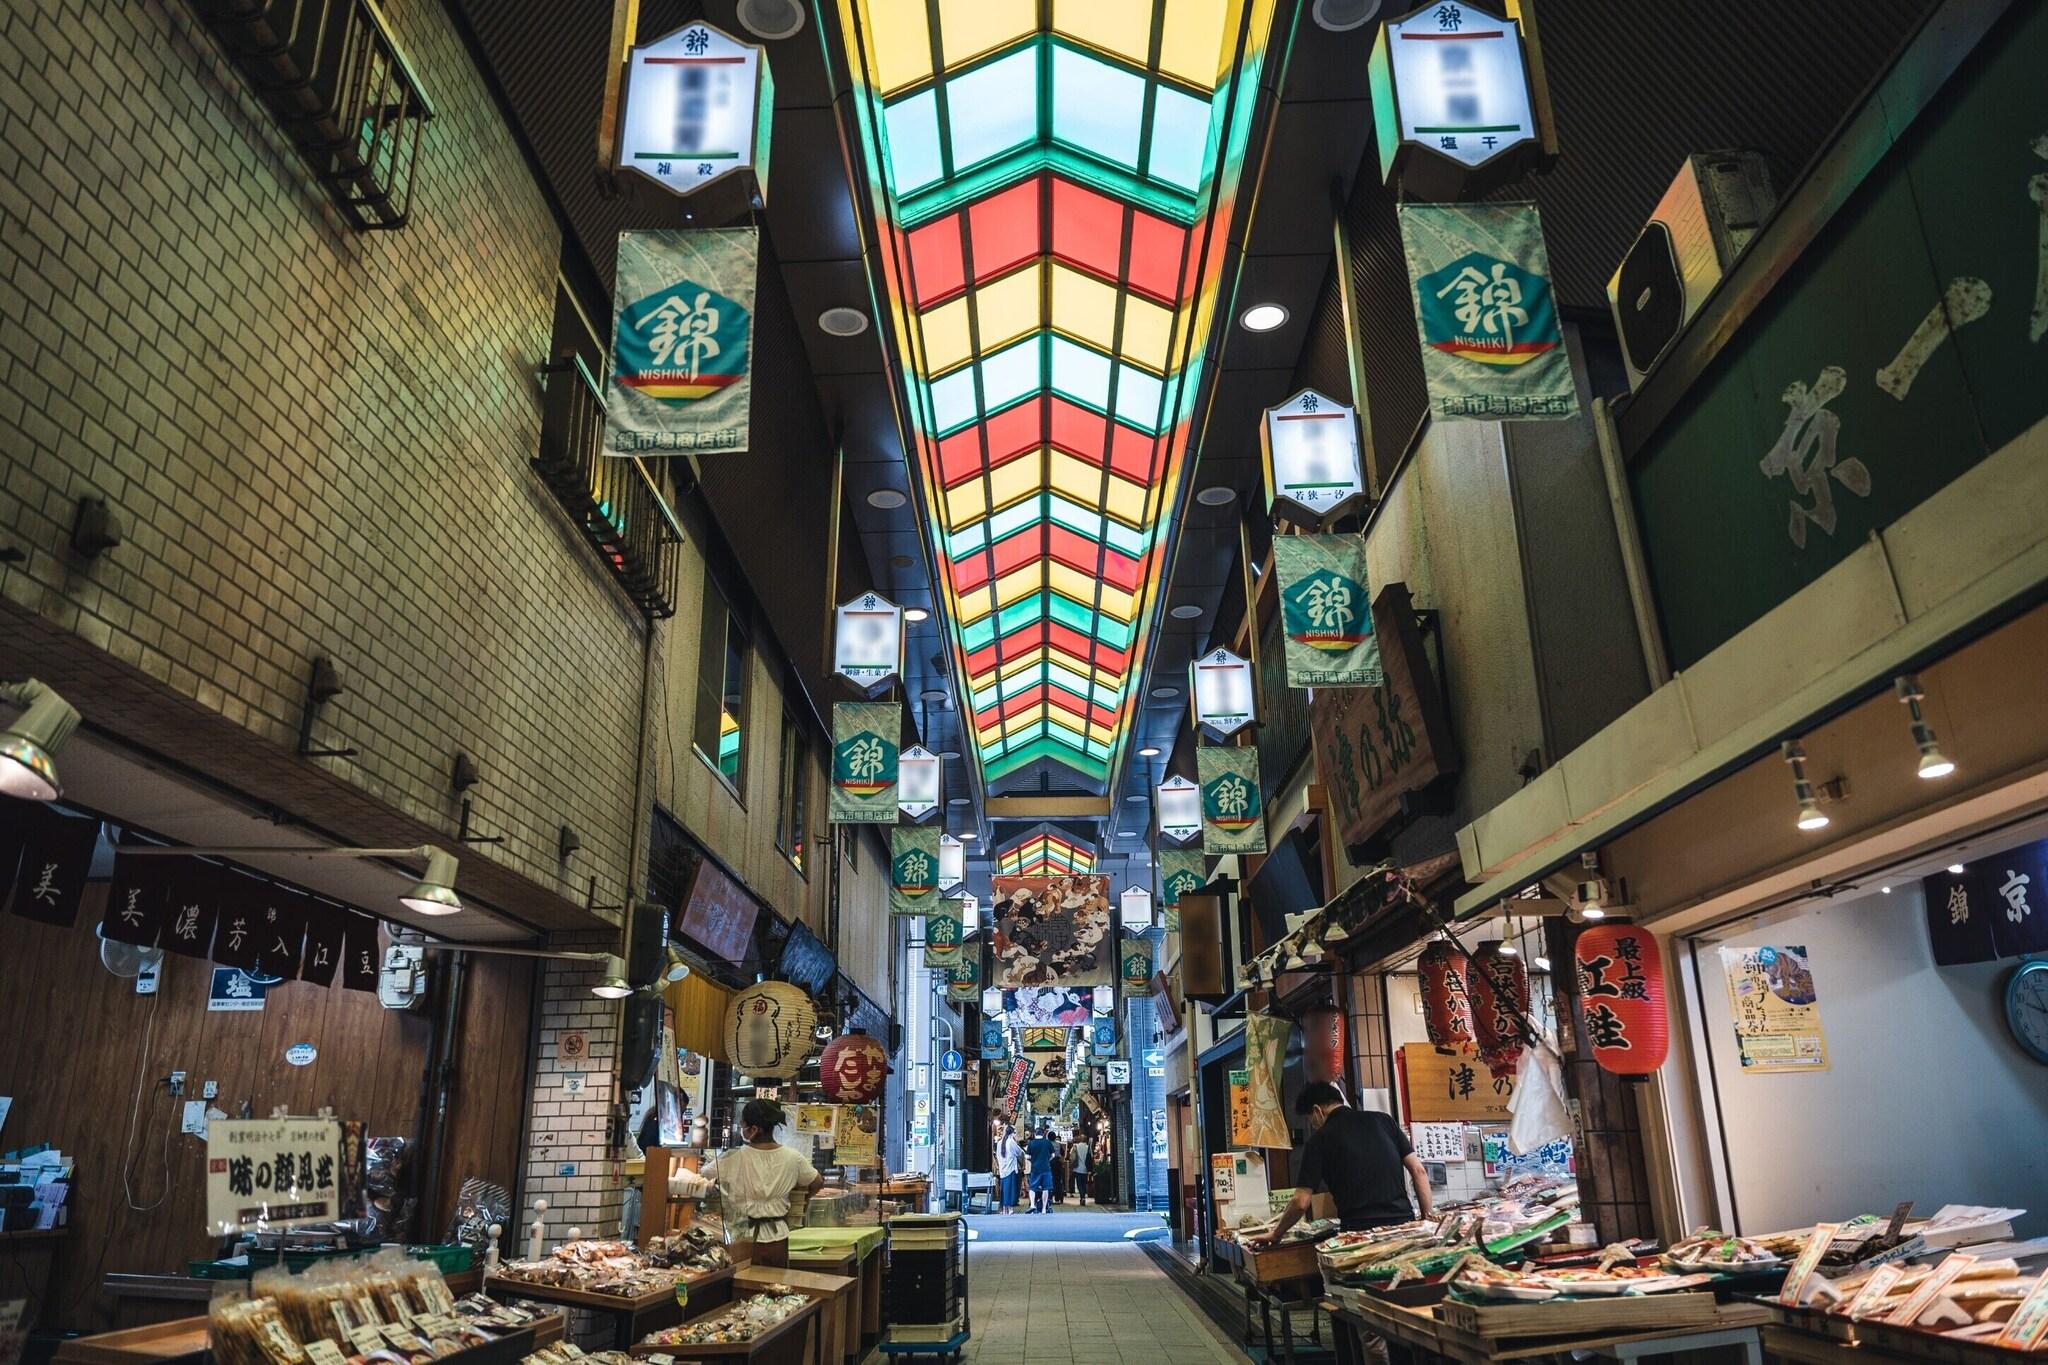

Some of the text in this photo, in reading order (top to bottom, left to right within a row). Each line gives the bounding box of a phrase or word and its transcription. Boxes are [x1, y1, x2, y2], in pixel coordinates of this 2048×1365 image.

[1433, 5, 1462, 31] 錦
[681, 28, 709, 56] 錦
[1436, 263, 1529, 352] 錦
[634, 291, 721, 384] 錦
[1454, 335, 1505, 349] NISHIKI
[639, 368, 690, 380] NISHIKI
[615, 429, 737, 450] 錦市場商店街
[1295, 576, 1354, 640] 錦
[1305, 629, 1340, 638] NISHIKI
[842, 737, 884, 786] 錦
[1210, 777, 1248, 822] 錦
[899, 852, 928, 889] 錦
[1948, 885, 1969, 925] 錦
[1999, 870, 2031, 924] 京
[931, 919, 954, 947] 錦
[1614, 937, 1650, 1001] 最上級
[226, 974, 252, 997] 塩
[752, 1000, 767, 1015] 福
